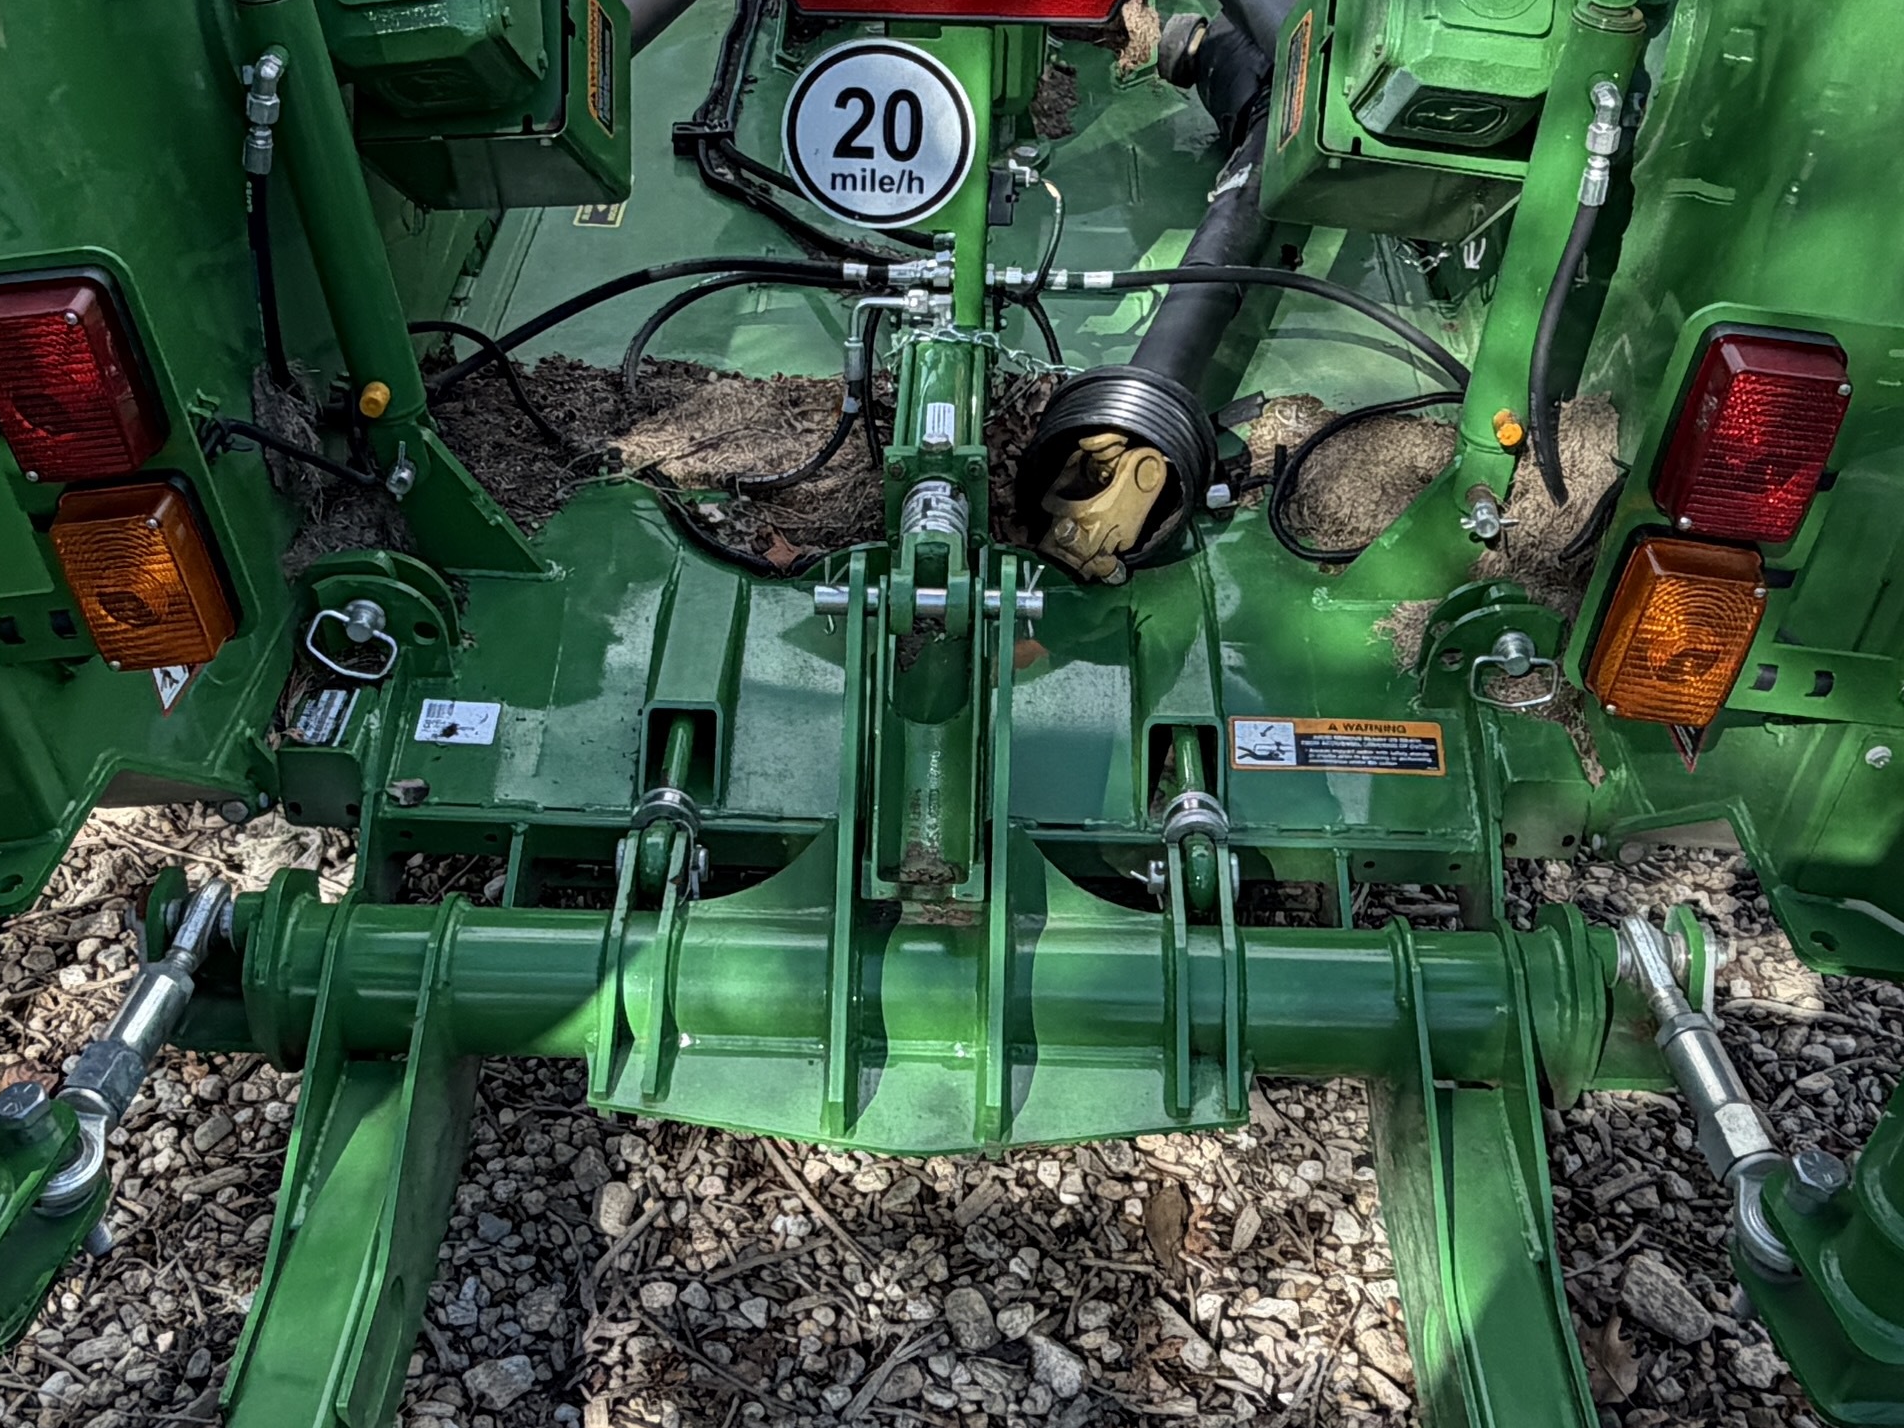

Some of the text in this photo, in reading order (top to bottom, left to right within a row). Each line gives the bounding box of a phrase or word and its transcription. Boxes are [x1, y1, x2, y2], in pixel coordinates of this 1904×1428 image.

[832, 86, 924, 163] 20
[830, 167, 925, 195] mile/h
[1342, 722, 1407, 734] WARNING
